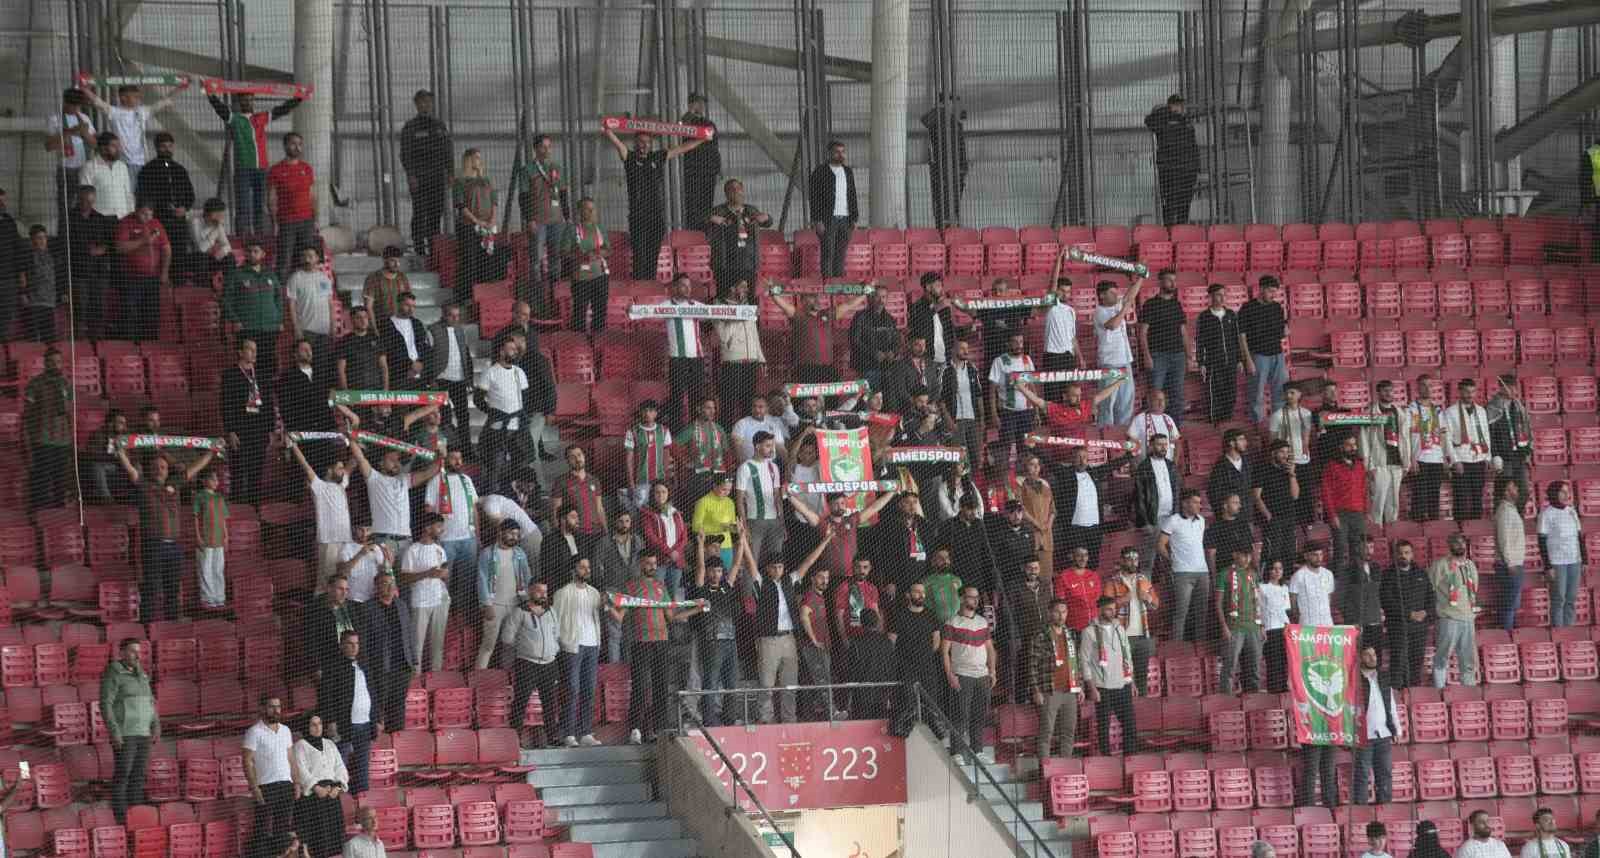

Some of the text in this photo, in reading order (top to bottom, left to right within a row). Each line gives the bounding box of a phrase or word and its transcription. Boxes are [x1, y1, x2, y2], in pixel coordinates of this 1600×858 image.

[967, 297, 1041, 310] AMEDSPOR
[796, 383, 859, 397] AMEDSPOR
[134, 435, 211, 448] AMEDSPOR
[892, 450, 961, 462] AMEDSPOR
[807, 480, 879, 493] AMEDSPOR
[822, 747, 878, 781] 223
